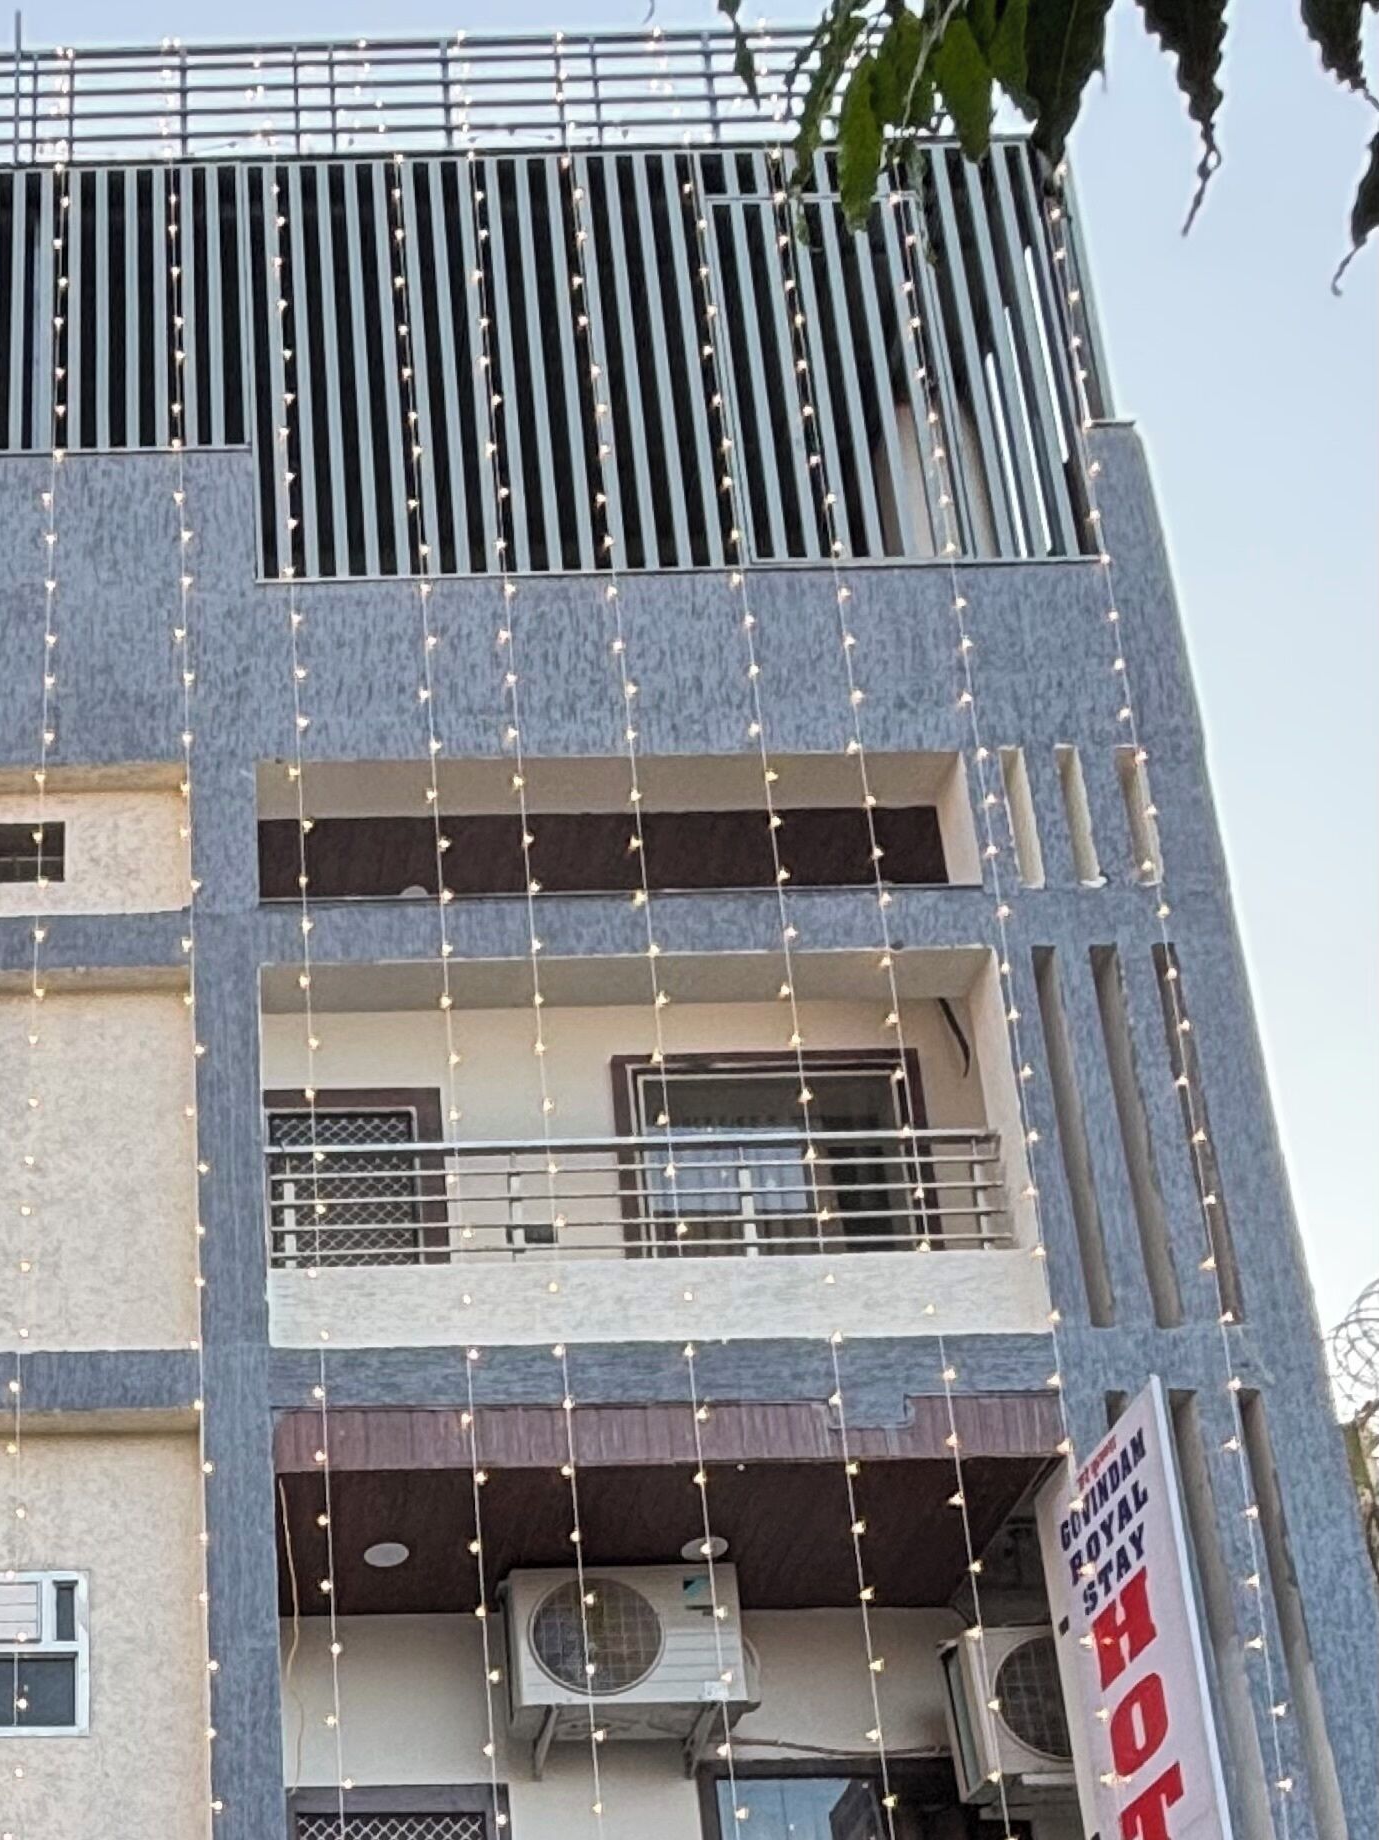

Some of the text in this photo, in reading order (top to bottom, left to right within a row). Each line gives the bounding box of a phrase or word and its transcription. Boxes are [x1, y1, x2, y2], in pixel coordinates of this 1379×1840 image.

[1060, 1427, 1146, 1551] GOVINDAM
[1070, 1479, 1149, 1586] ROYAL
[1083, 1522, 1145, 1615] STAY
